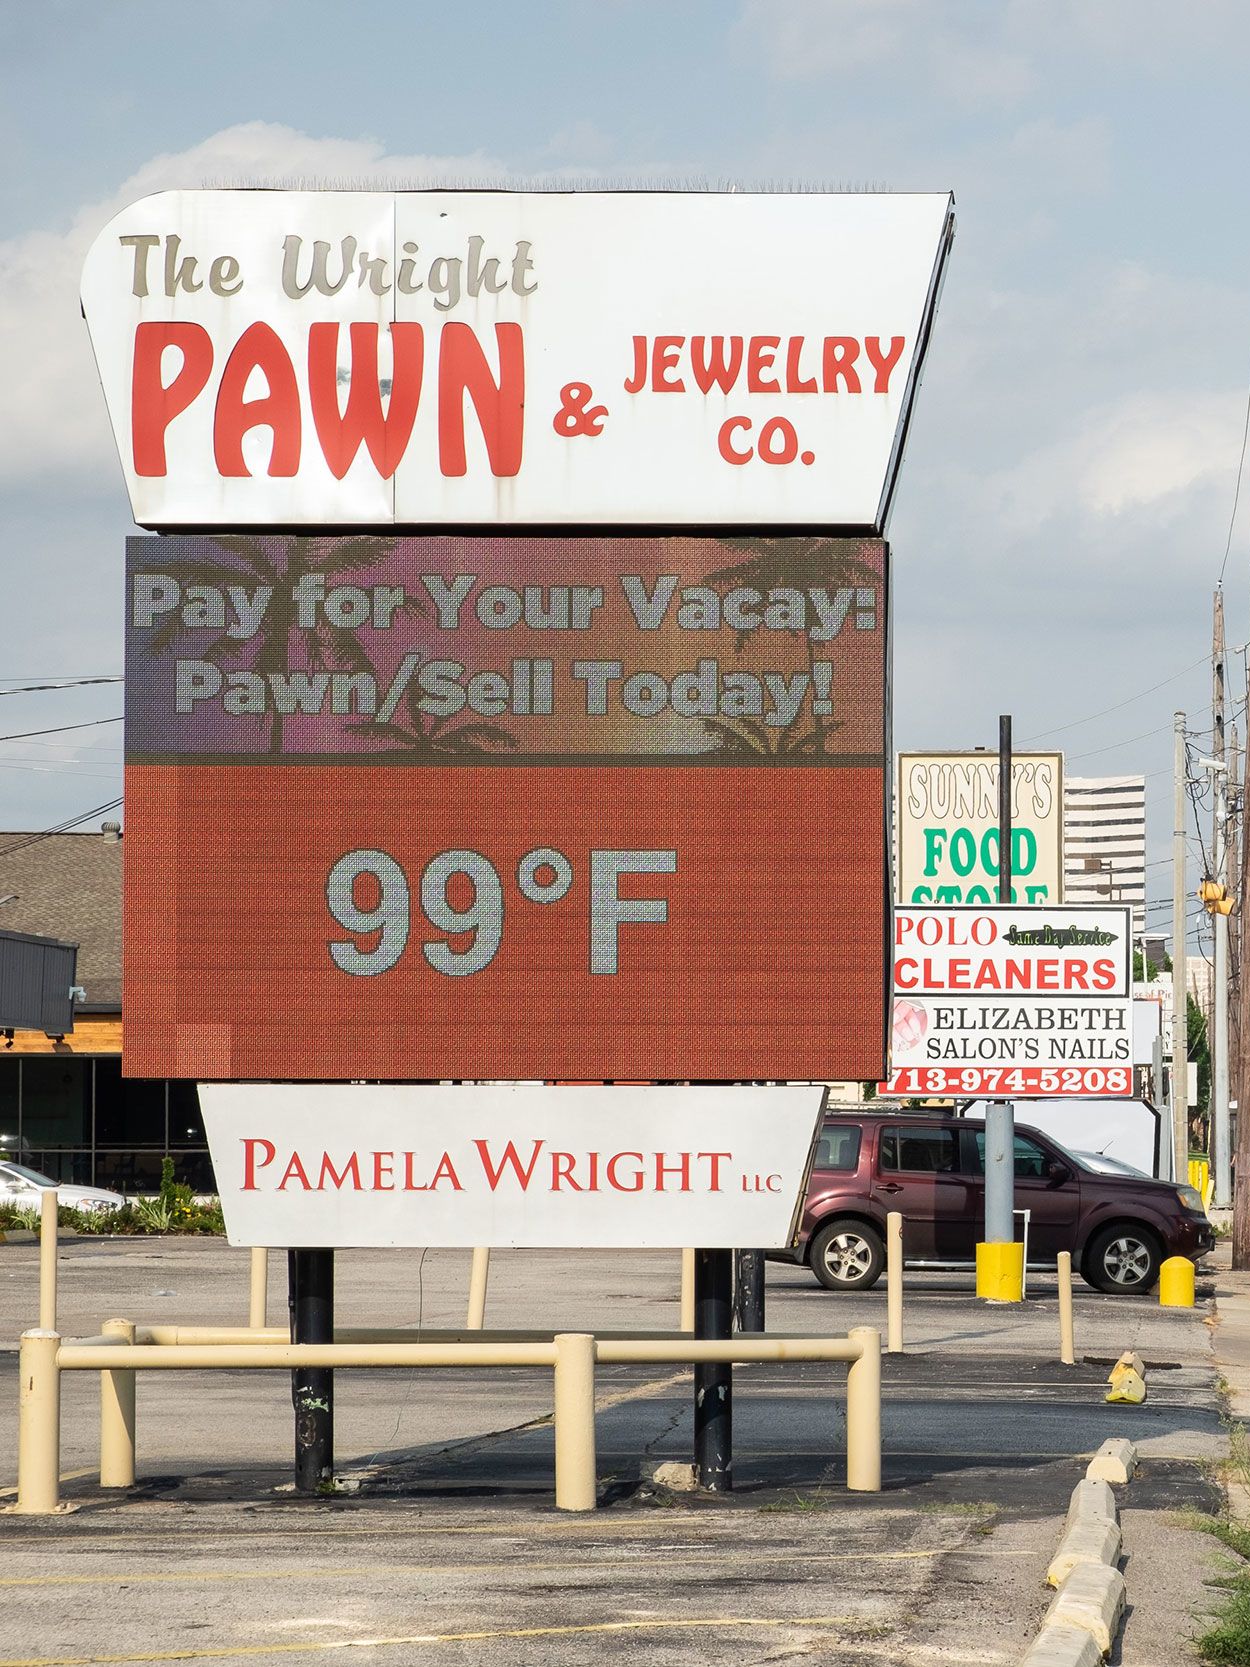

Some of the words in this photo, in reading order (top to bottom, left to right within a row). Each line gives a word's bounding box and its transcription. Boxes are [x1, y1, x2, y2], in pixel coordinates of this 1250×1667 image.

[120, 234, 243, 299] The
[282, 234, 539, 312] Wright
[132, 320, 525, 480] PAWN
[553, 382, 609, 437] &
[623, 335, 906, 394] JEWELRY
[718, 415, 815, 466] CO.
[132, 573, 273, 639] Pay
[292, 573, 406, 630] for
[421, 573, 603, 630] Your
[174, 653, 554, 723] Pawn/Sell
[574, 660, 834, 727] Today!
[908, 763, 1053, 819] SUNNY'S
[923, 828, 1037, 877] FOOD
[326, 847, 676, 977] 99°F
[895, 917, 998, 946] POLO
[894, 958, 1116, 990] CLEANERS
[933, 1008, 1125, 1030] ELIZABETH
[926, 1037, 1040, 1060] SALON'S
[1048, 1037, 1130, 1060] NAILS
[886, 1068, 1128, 1092] 713-974-5208
[239, 1138, 466, 1193] PAMELA
[471, 1139, 732, 1193] WRIGHT
[742, 1174, 782, 1193] LLC
